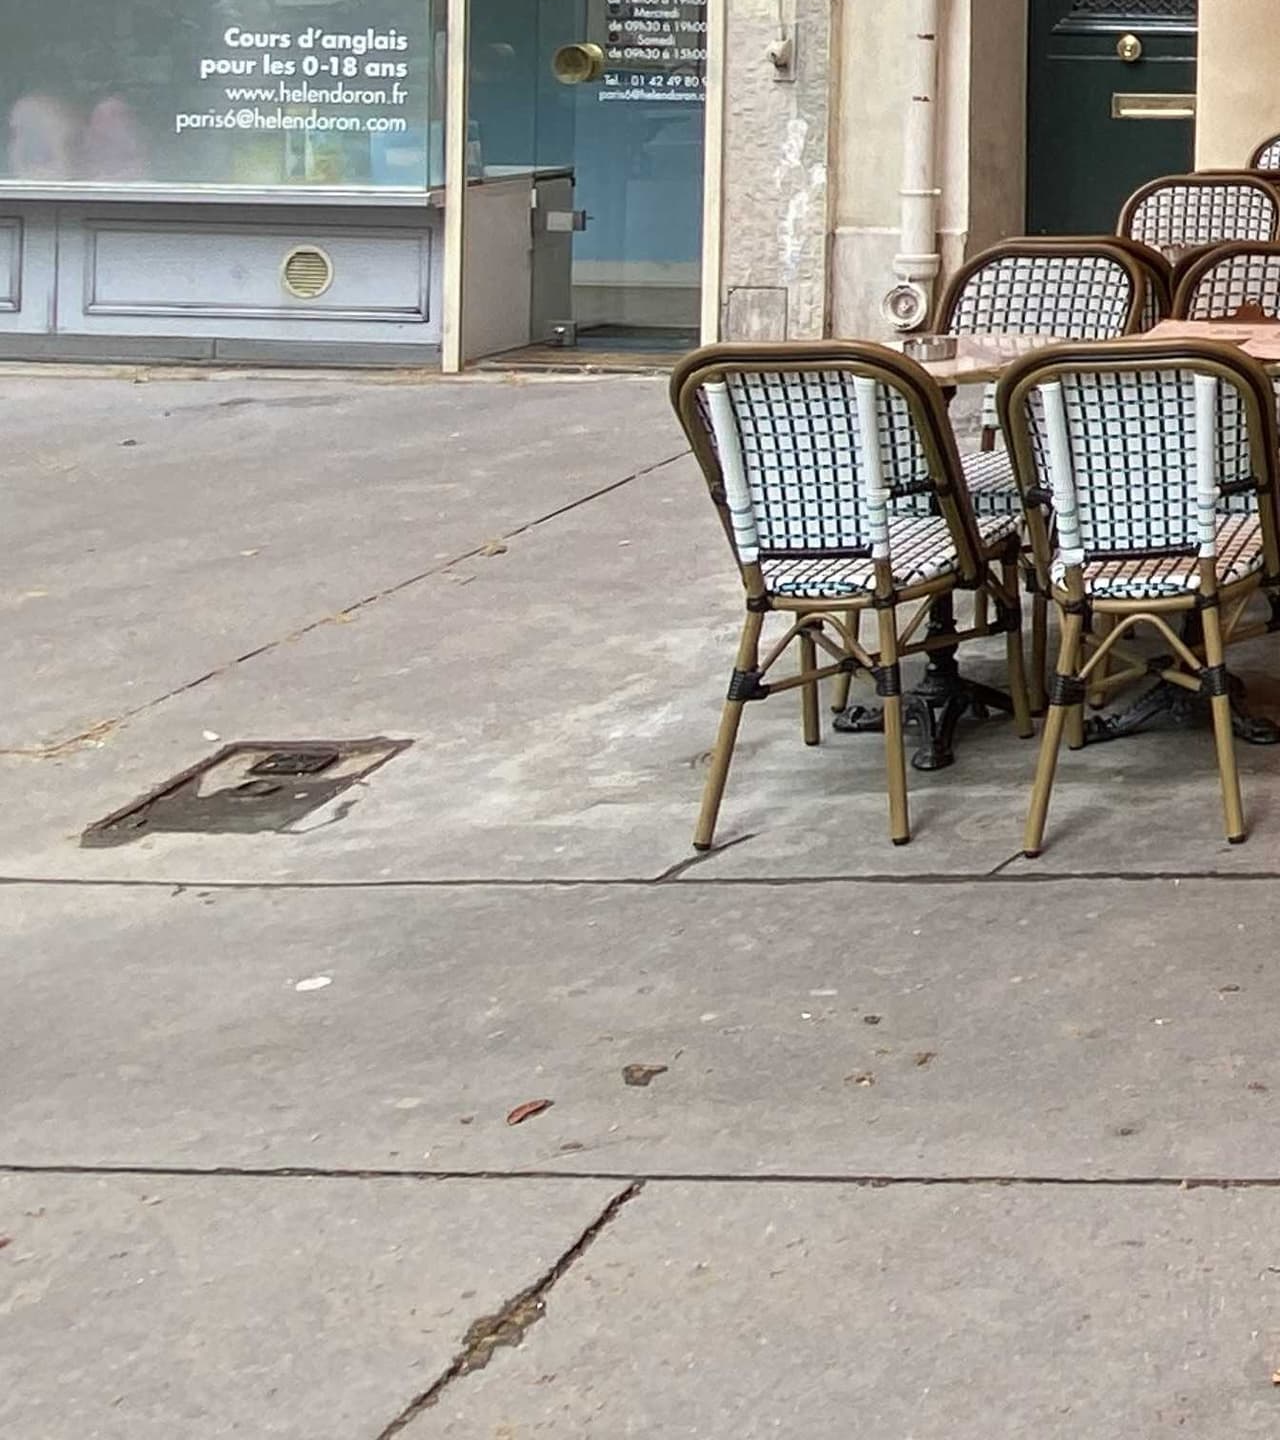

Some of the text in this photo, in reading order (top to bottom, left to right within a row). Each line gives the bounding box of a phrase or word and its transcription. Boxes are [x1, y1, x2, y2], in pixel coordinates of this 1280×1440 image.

[224, 27, 291, 48] Cours
[200, 54, 408, 79] pour les 0-18 ans
[225, 80, 408, 104] www.helendoron.fr
[176, 108, 407, 132] paris6@helendoron.com
